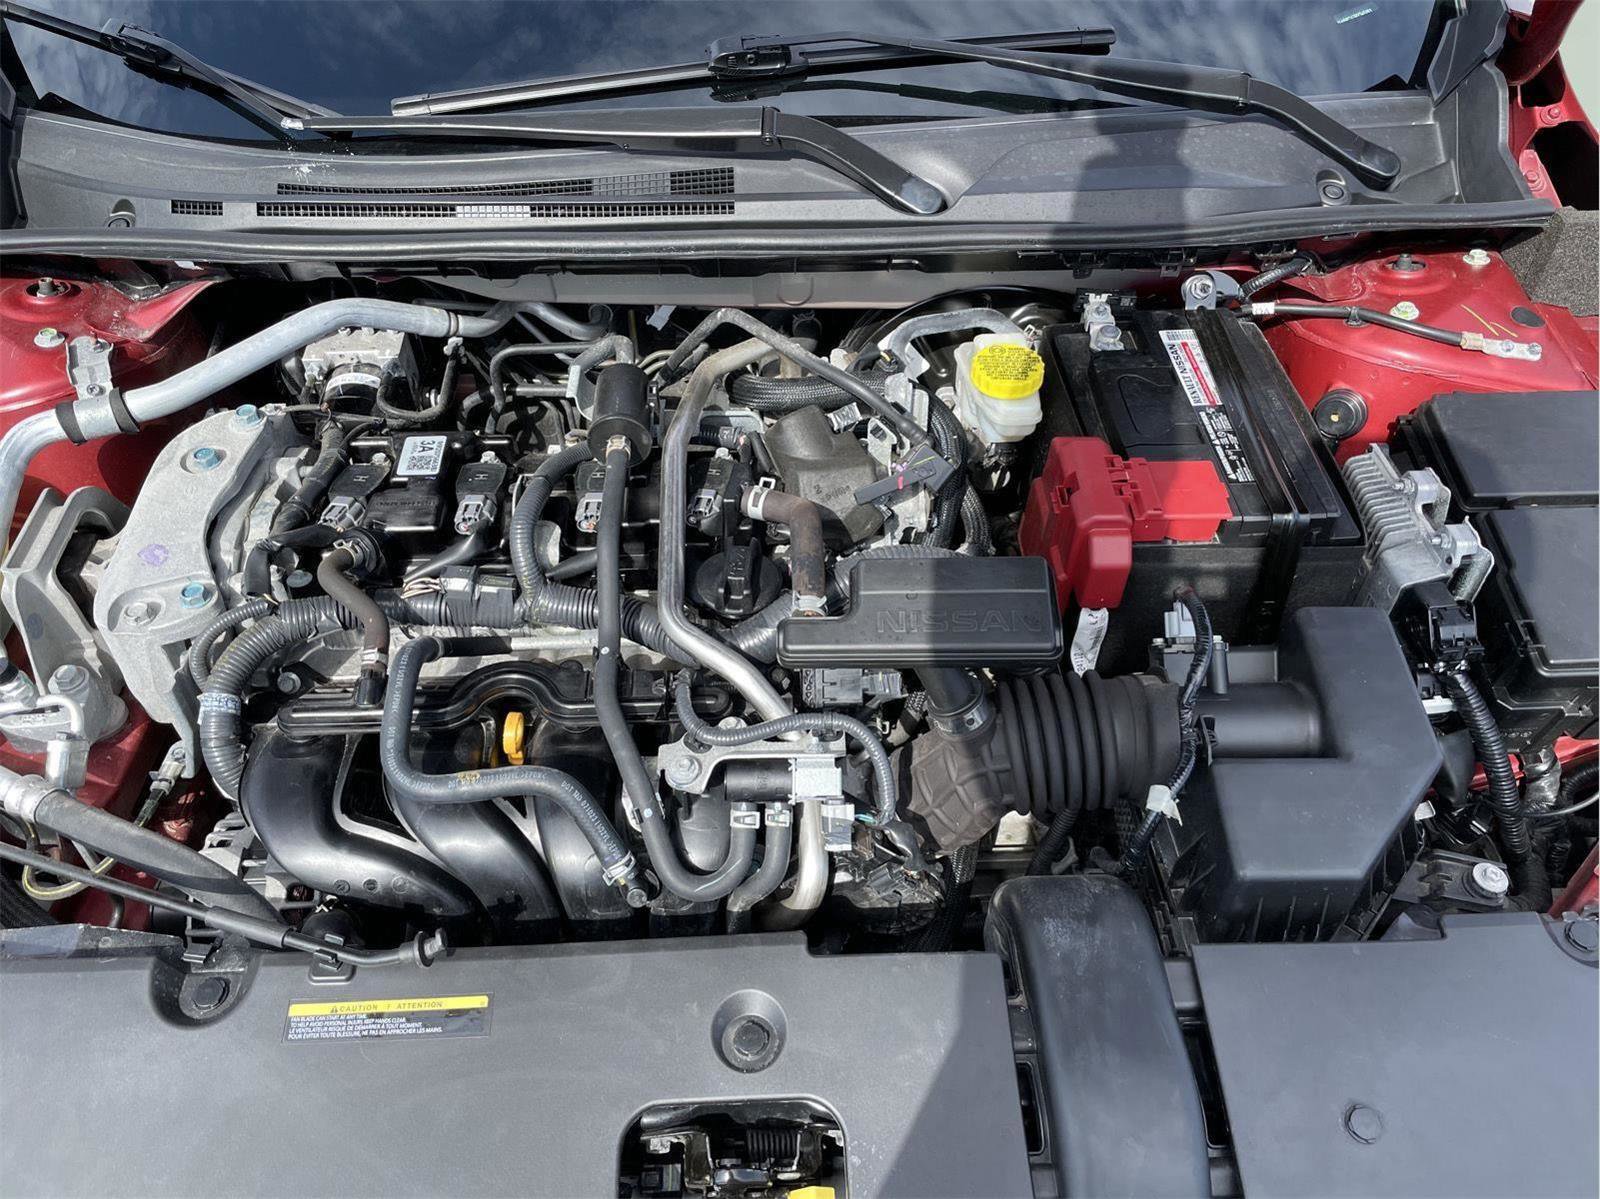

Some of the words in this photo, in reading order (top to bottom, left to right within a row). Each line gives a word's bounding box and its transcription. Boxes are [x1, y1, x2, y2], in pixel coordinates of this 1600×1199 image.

[1167, 343, 1189, 377] NISSAN
[1183, 373, 1203, 405] RENAULT
[417, 440, 434, 454] 3A
[877, 609, 1043, 633] NISSAN
